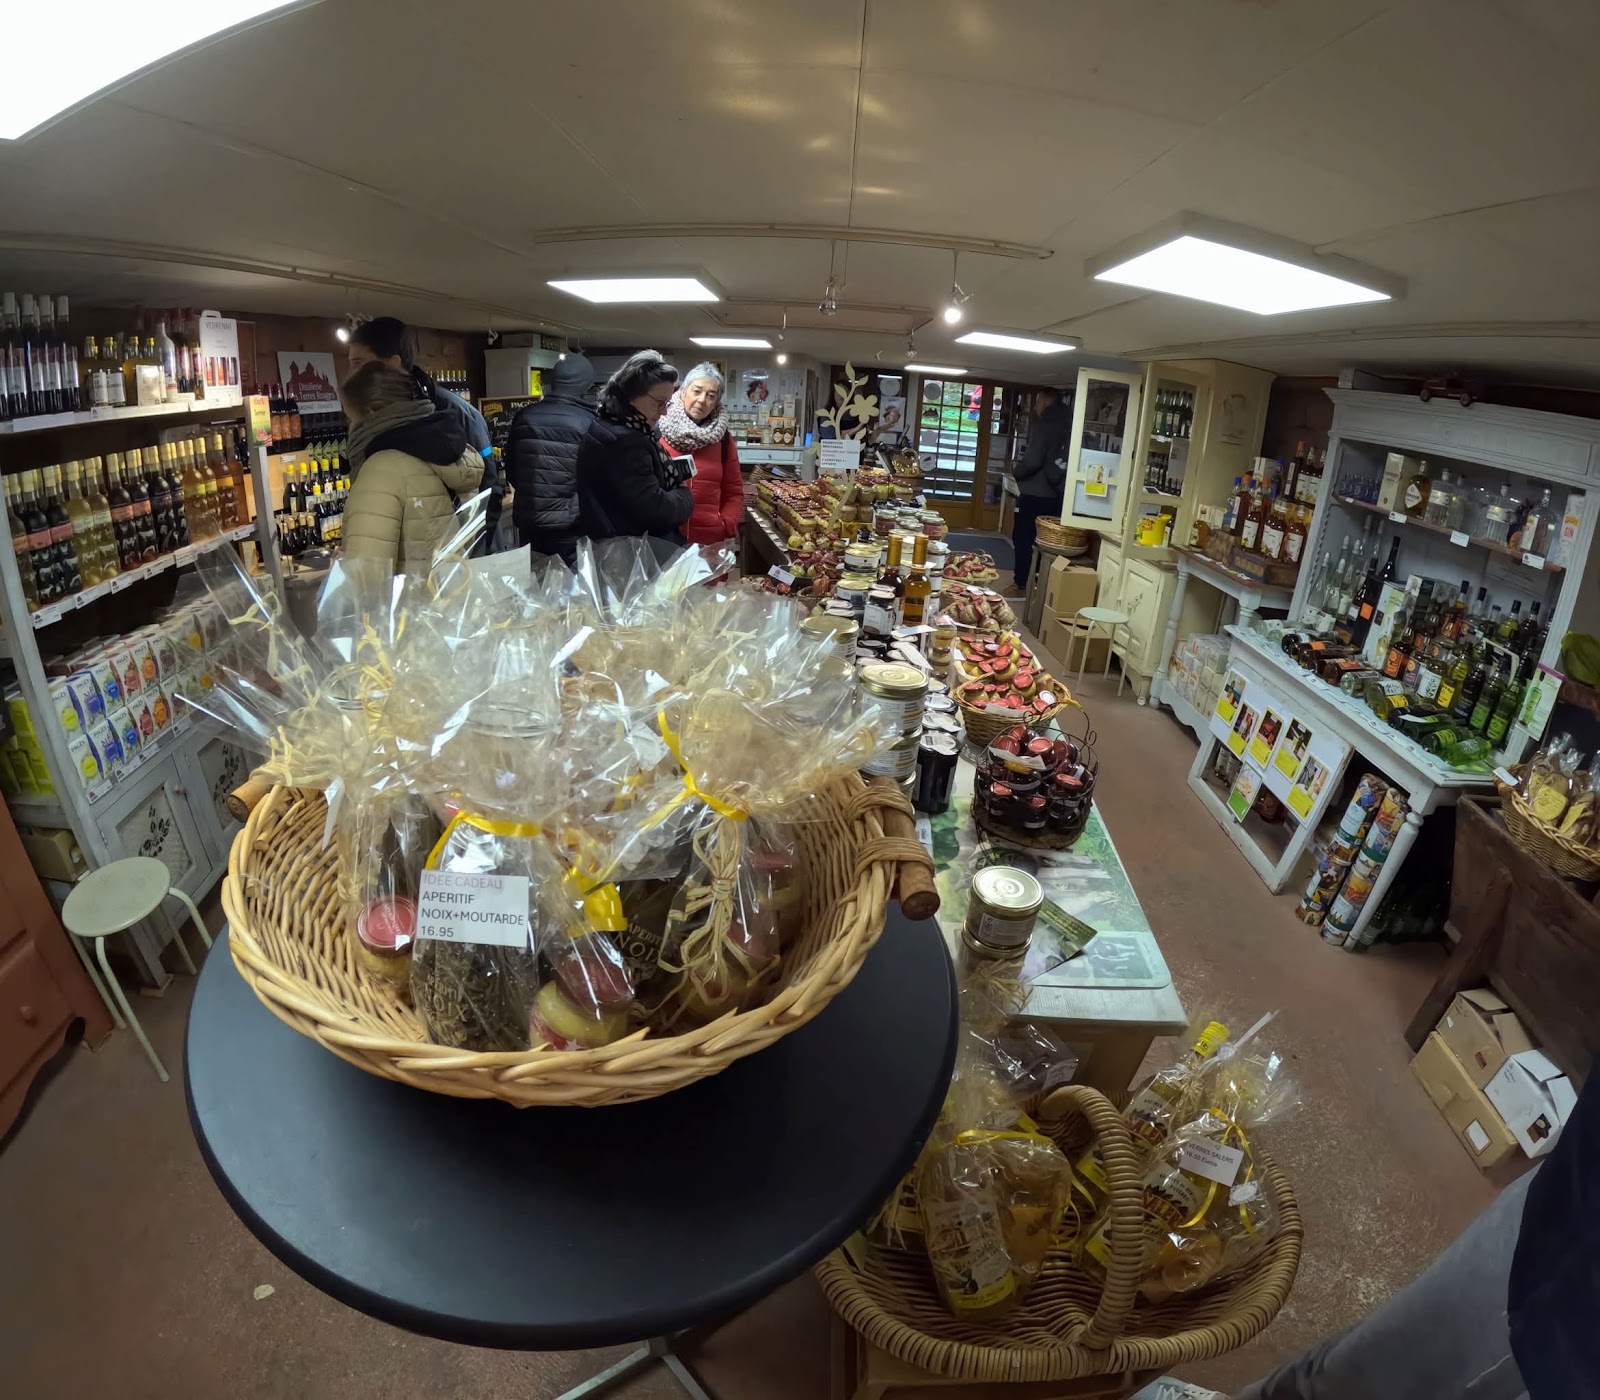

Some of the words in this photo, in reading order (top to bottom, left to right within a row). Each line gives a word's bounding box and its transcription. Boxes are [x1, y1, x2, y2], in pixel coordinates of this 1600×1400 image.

[423, 874, 452, 886] IDEE
[455, 876, 503, 890] CADEAU
[422, 891, 475, 904] APERITIF
[421, 908, 524, 925] NOIX+MOUTARDE
[421, 926, 454, 937] 16.95
[614, 932, 656, 962] NOI
[1188, 1142, 1210, 1155] VERRES
[1212, 1152, 1234, 1164] SALERS
